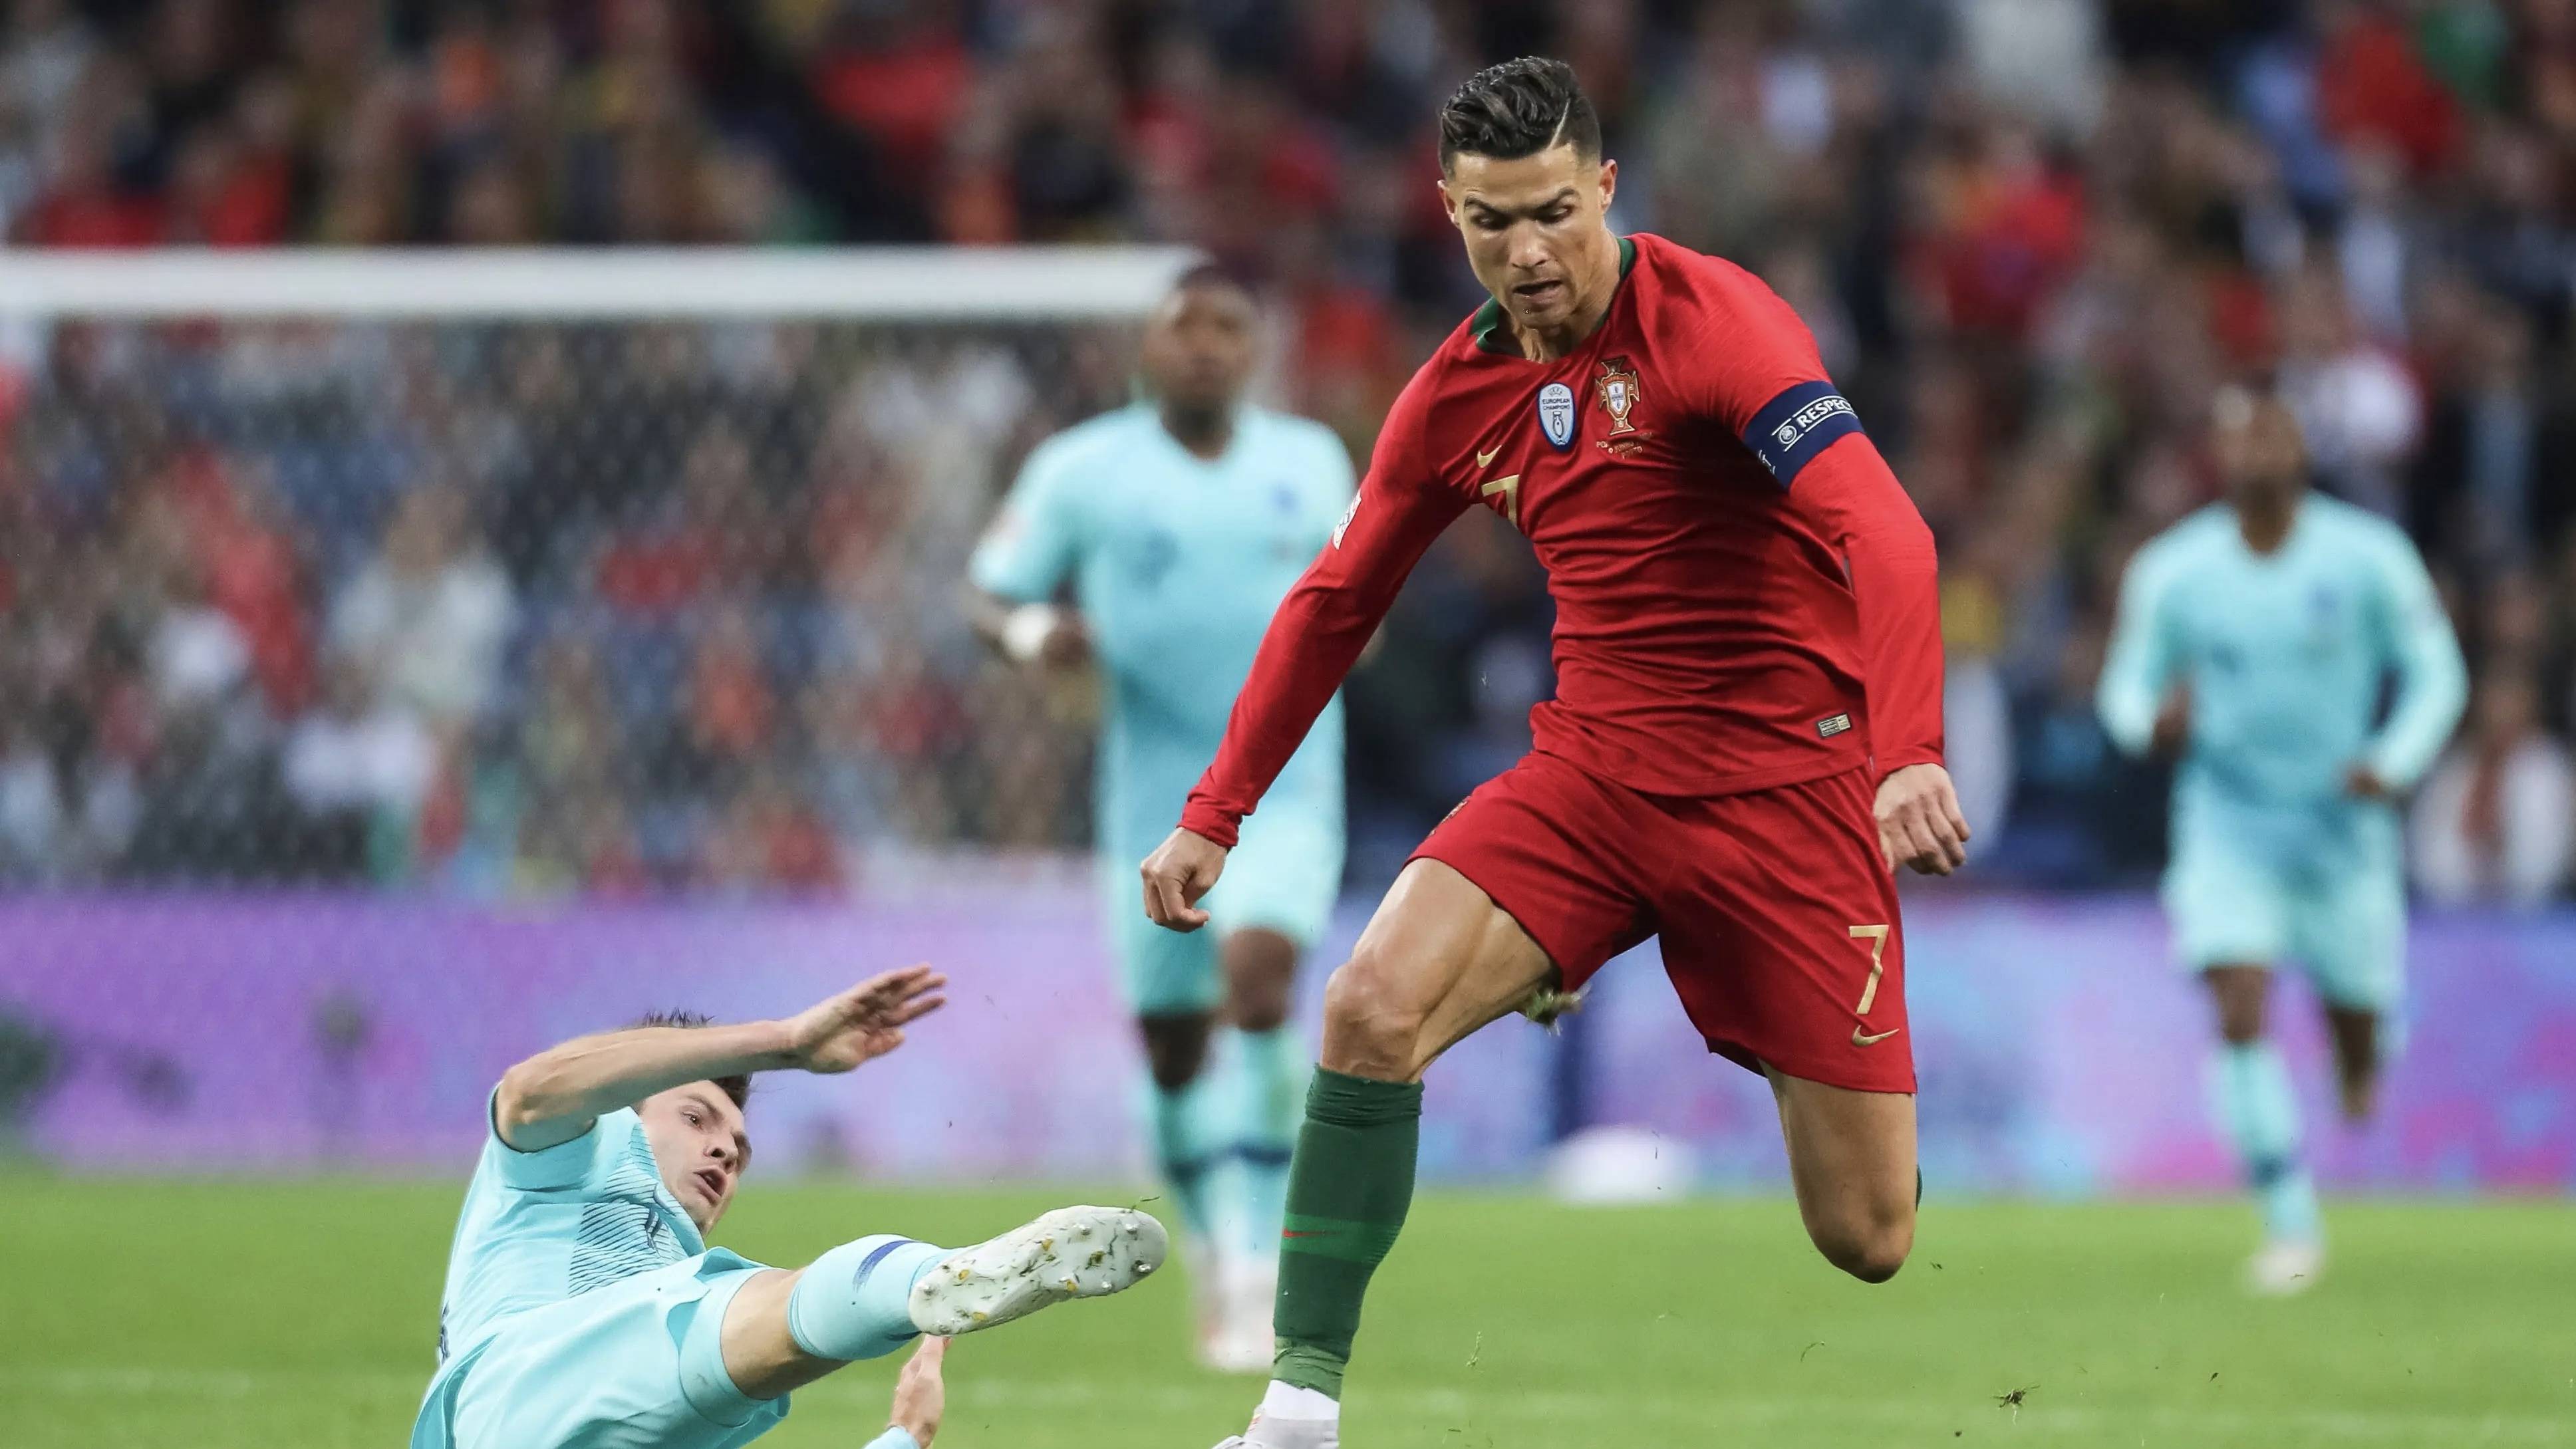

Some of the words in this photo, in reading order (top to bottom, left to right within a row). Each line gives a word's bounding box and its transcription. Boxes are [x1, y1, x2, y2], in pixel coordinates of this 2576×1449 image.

[1796, 399, 1854, 428] RESPEC
[1481, 474, 1520, 530] 7
[1849, 924, 1889, 1015] 7
